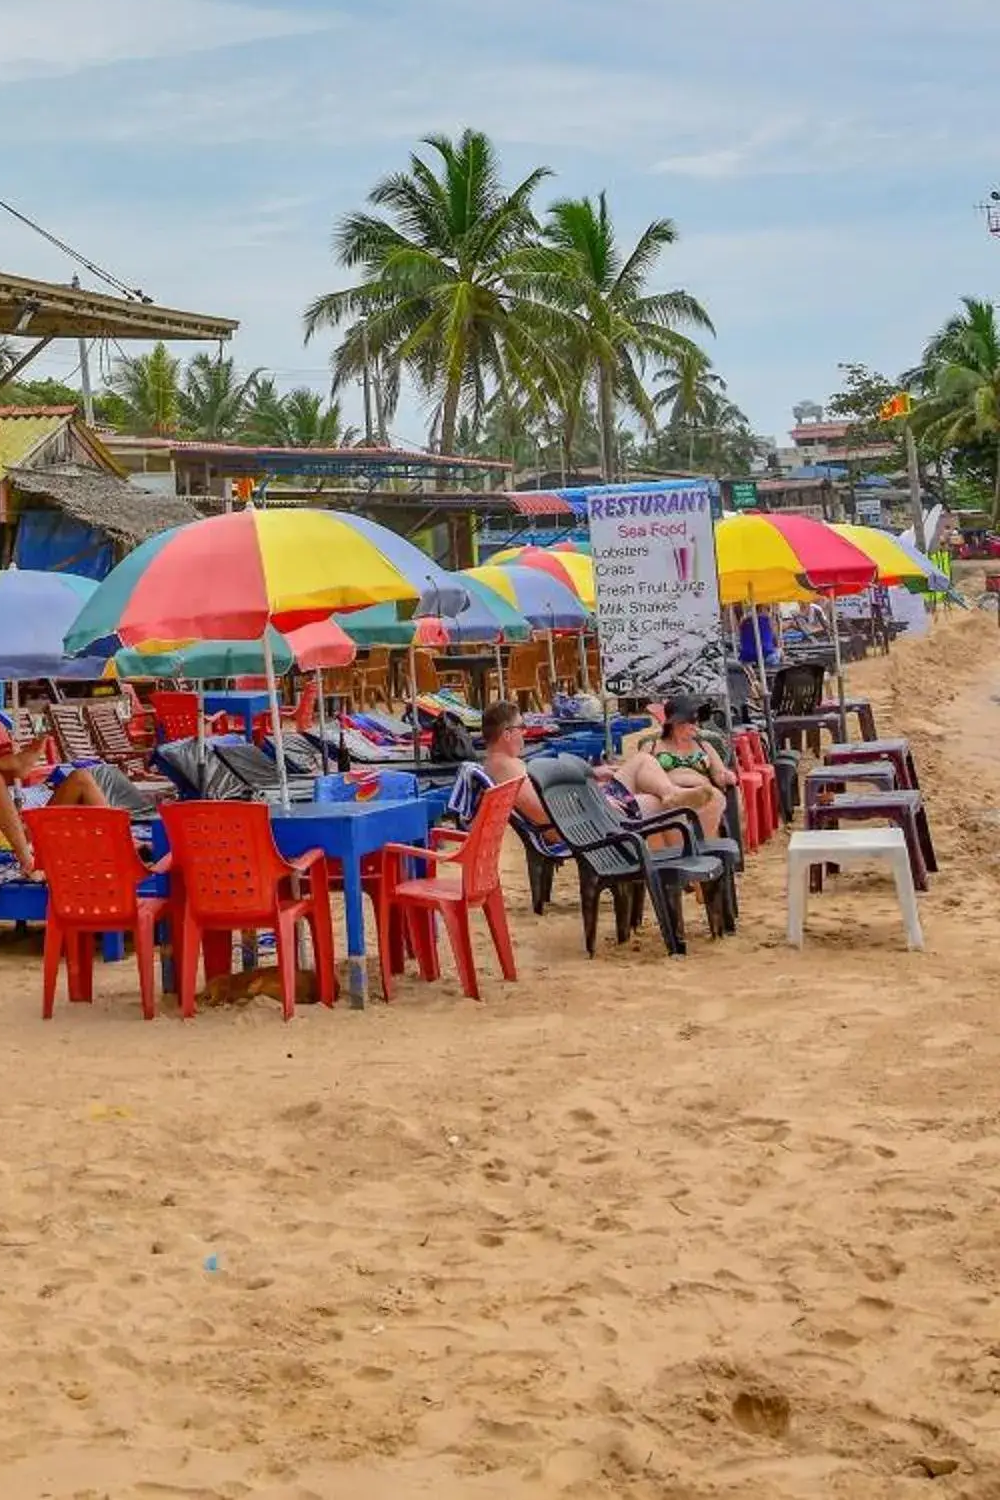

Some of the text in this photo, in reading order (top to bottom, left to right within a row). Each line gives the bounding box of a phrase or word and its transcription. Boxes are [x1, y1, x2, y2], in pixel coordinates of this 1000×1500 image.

[590, 491, 707, 519] RESTURANT
[618, 520, 687, 538] Sea Food
[594, 546, 648, 559] Lobsters
[596, 563, 635, 576] Crabs
[598, 583, 635, 596] Fresh
[639, 581, 668, 593] Fruit
[599, 601, 678, 615] Milk Shakes
[602, 618, 685, 632] Tea & Coffee
